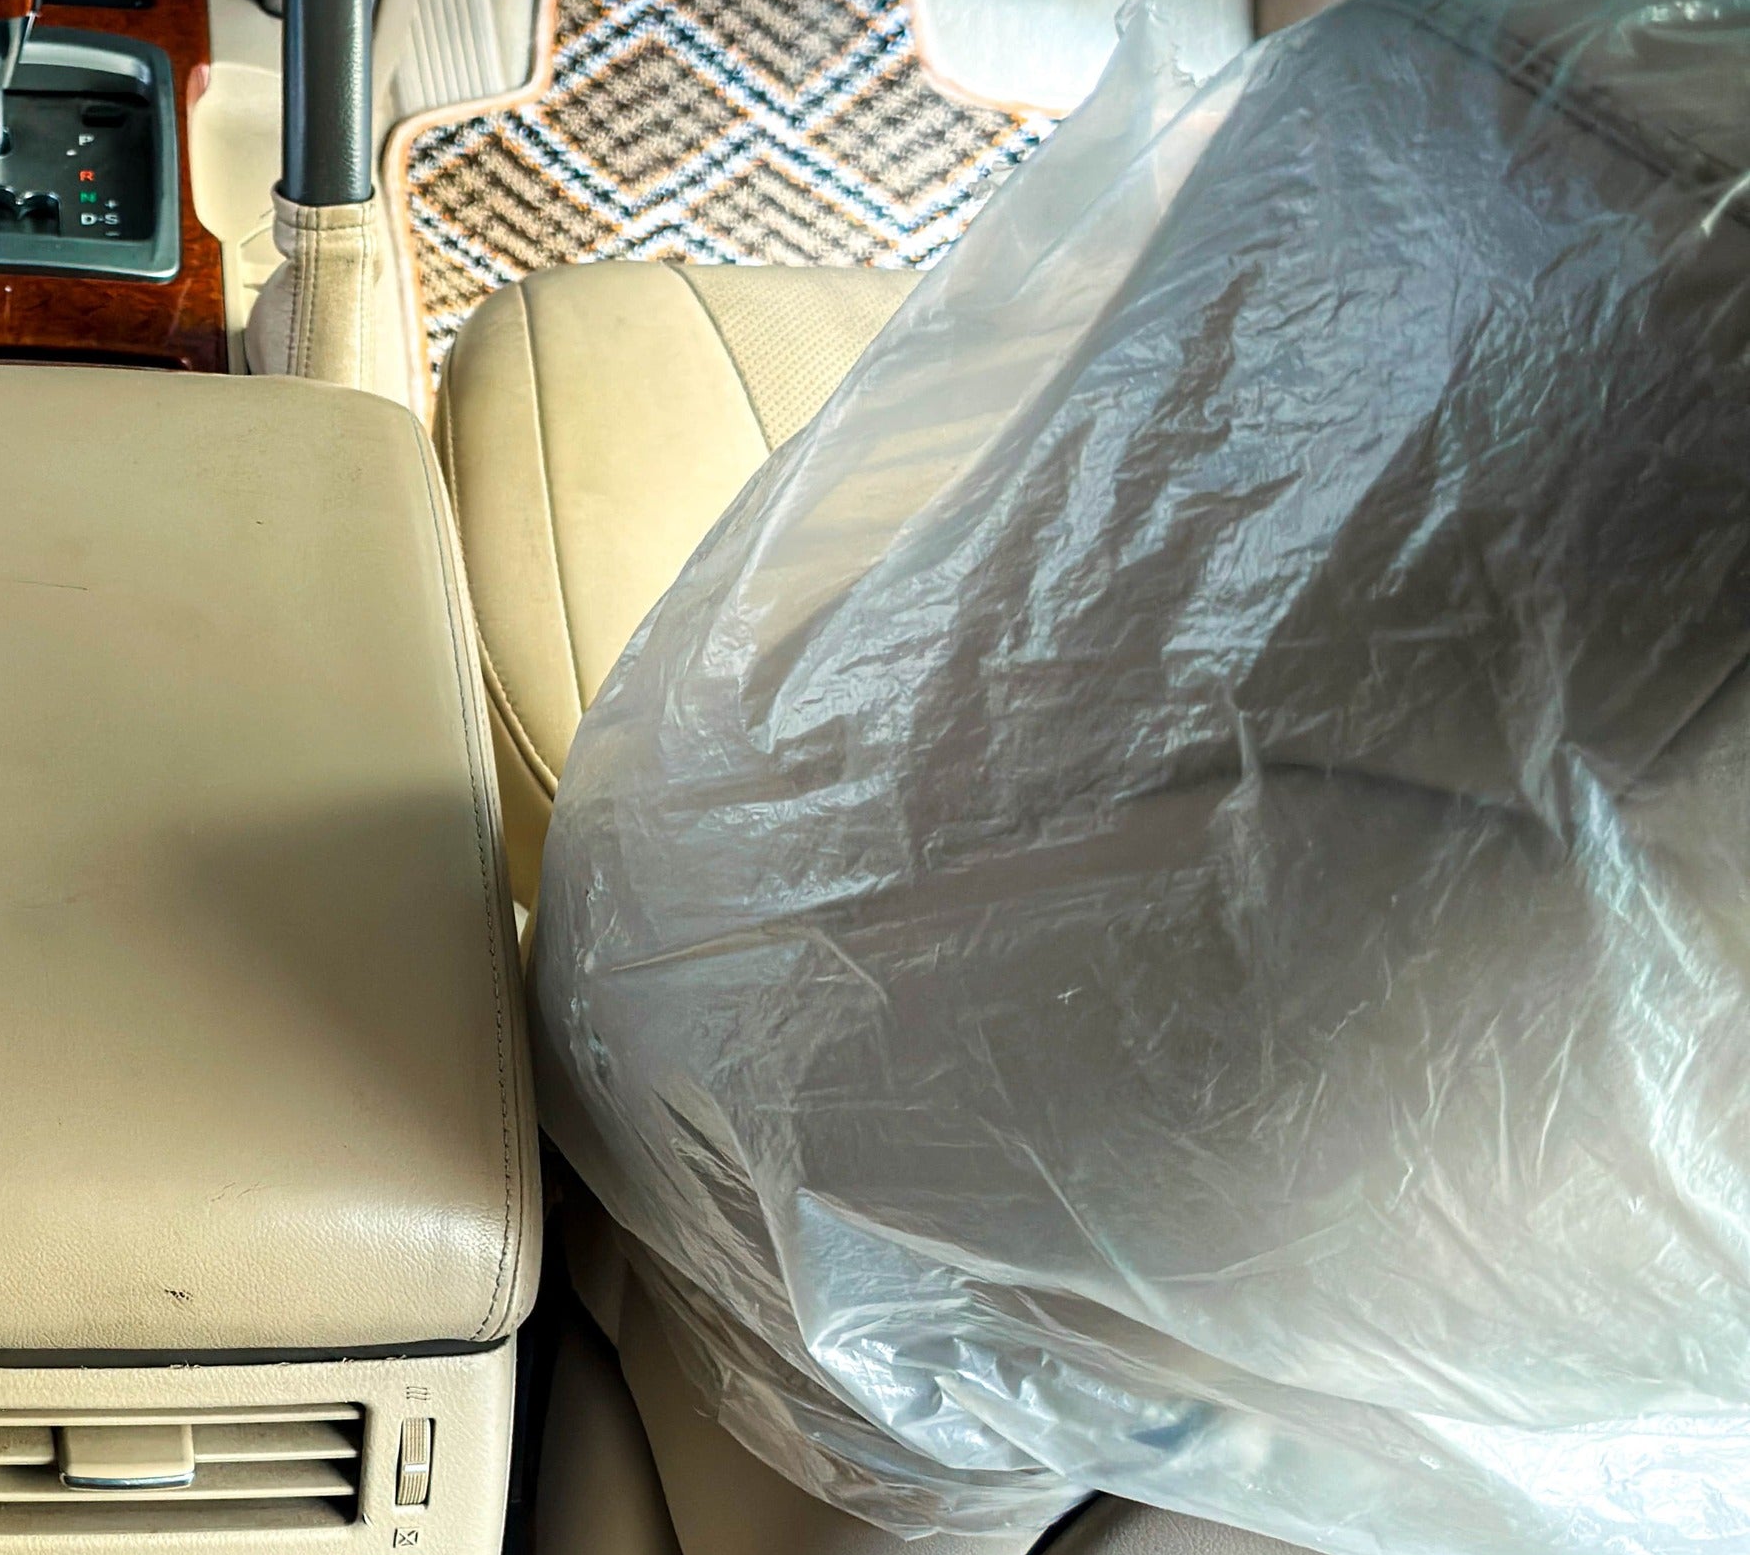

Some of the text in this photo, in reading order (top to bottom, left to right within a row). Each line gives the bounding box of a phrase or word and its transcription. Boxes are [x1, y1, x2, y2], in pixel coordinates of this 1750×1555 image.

[78, 133, 95, 146] P
[79, 169, 94, 182] R
[79, 191, 97, 204] N
